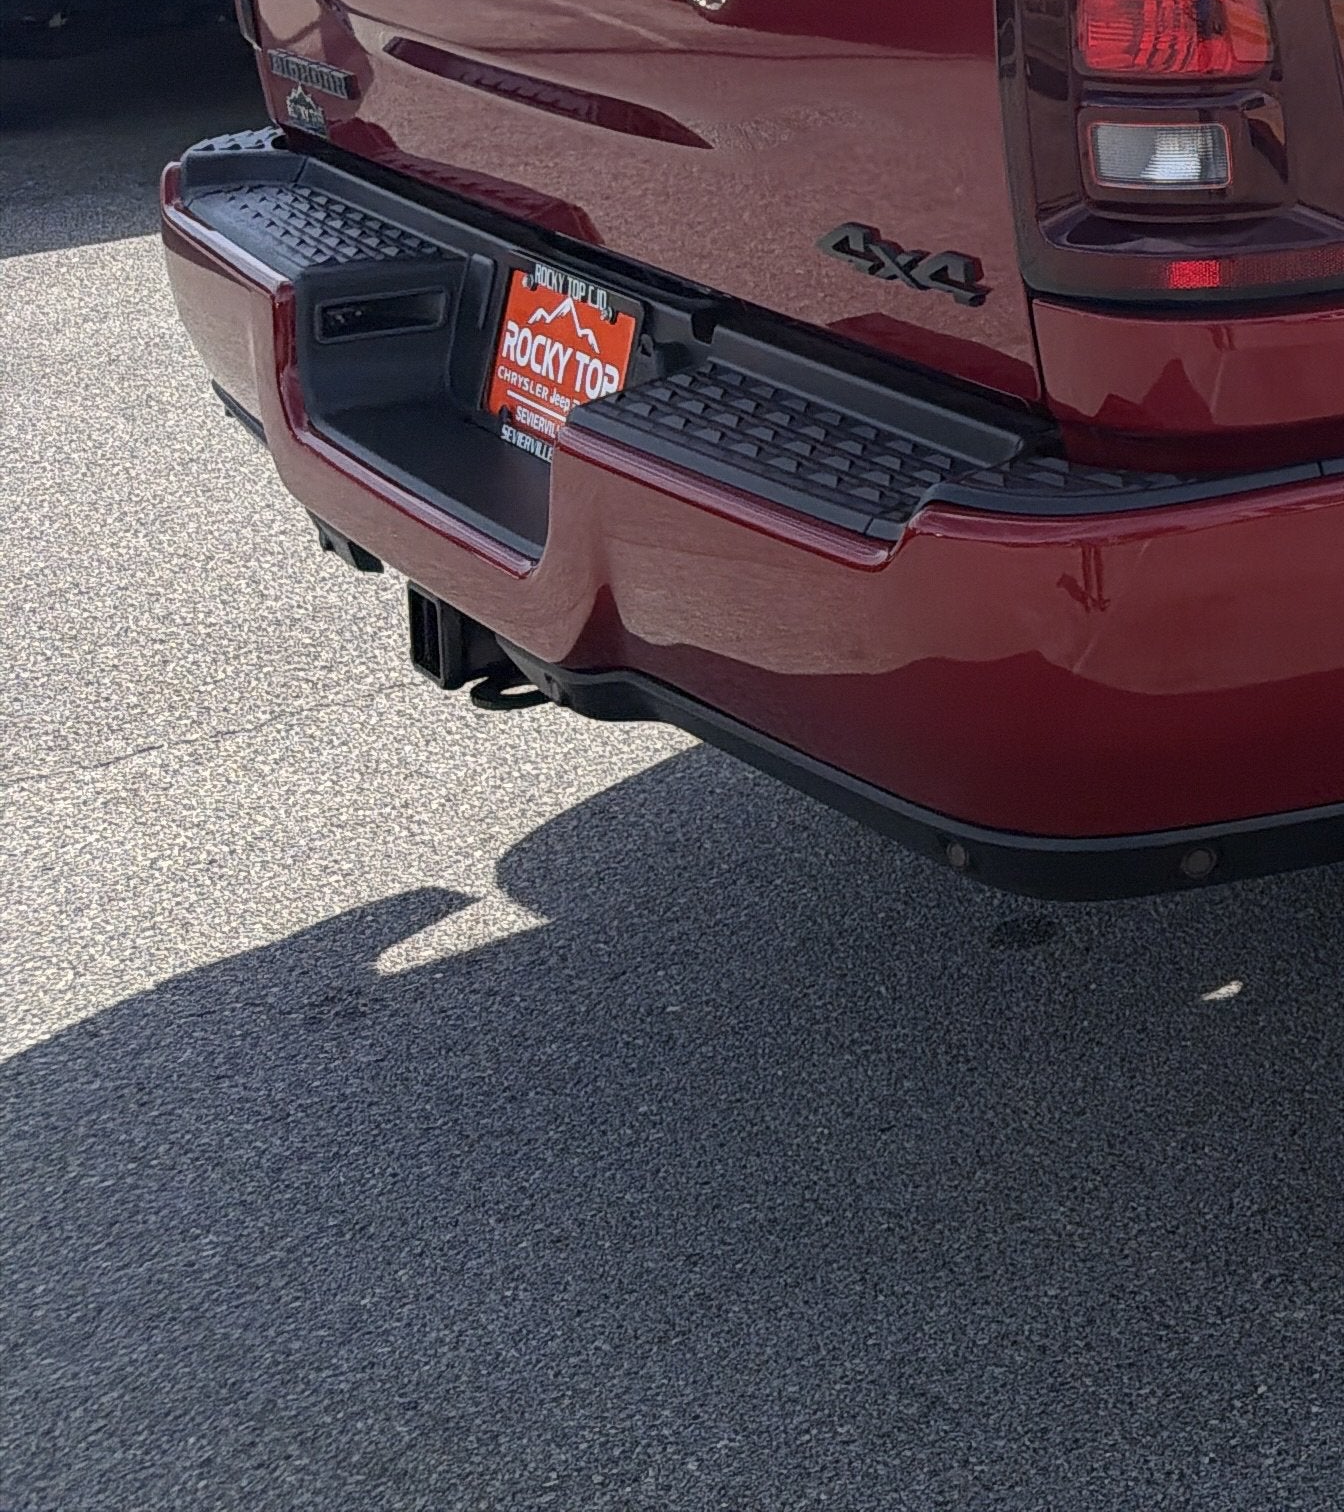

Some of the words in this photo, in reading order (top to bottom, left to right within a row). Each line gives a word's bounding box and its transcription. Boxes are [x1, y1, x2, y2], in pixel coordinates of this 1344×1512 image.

[534, 263, 565, 294] ROCKY
[567, 275, 586, 302] TOP
[502, 320, 574, 384] ROCKY
[575, 351, 619, 400] TOP
[497, 365, 549, 401] CHRYSLER
[550, 387, 571, 412] Jeep
